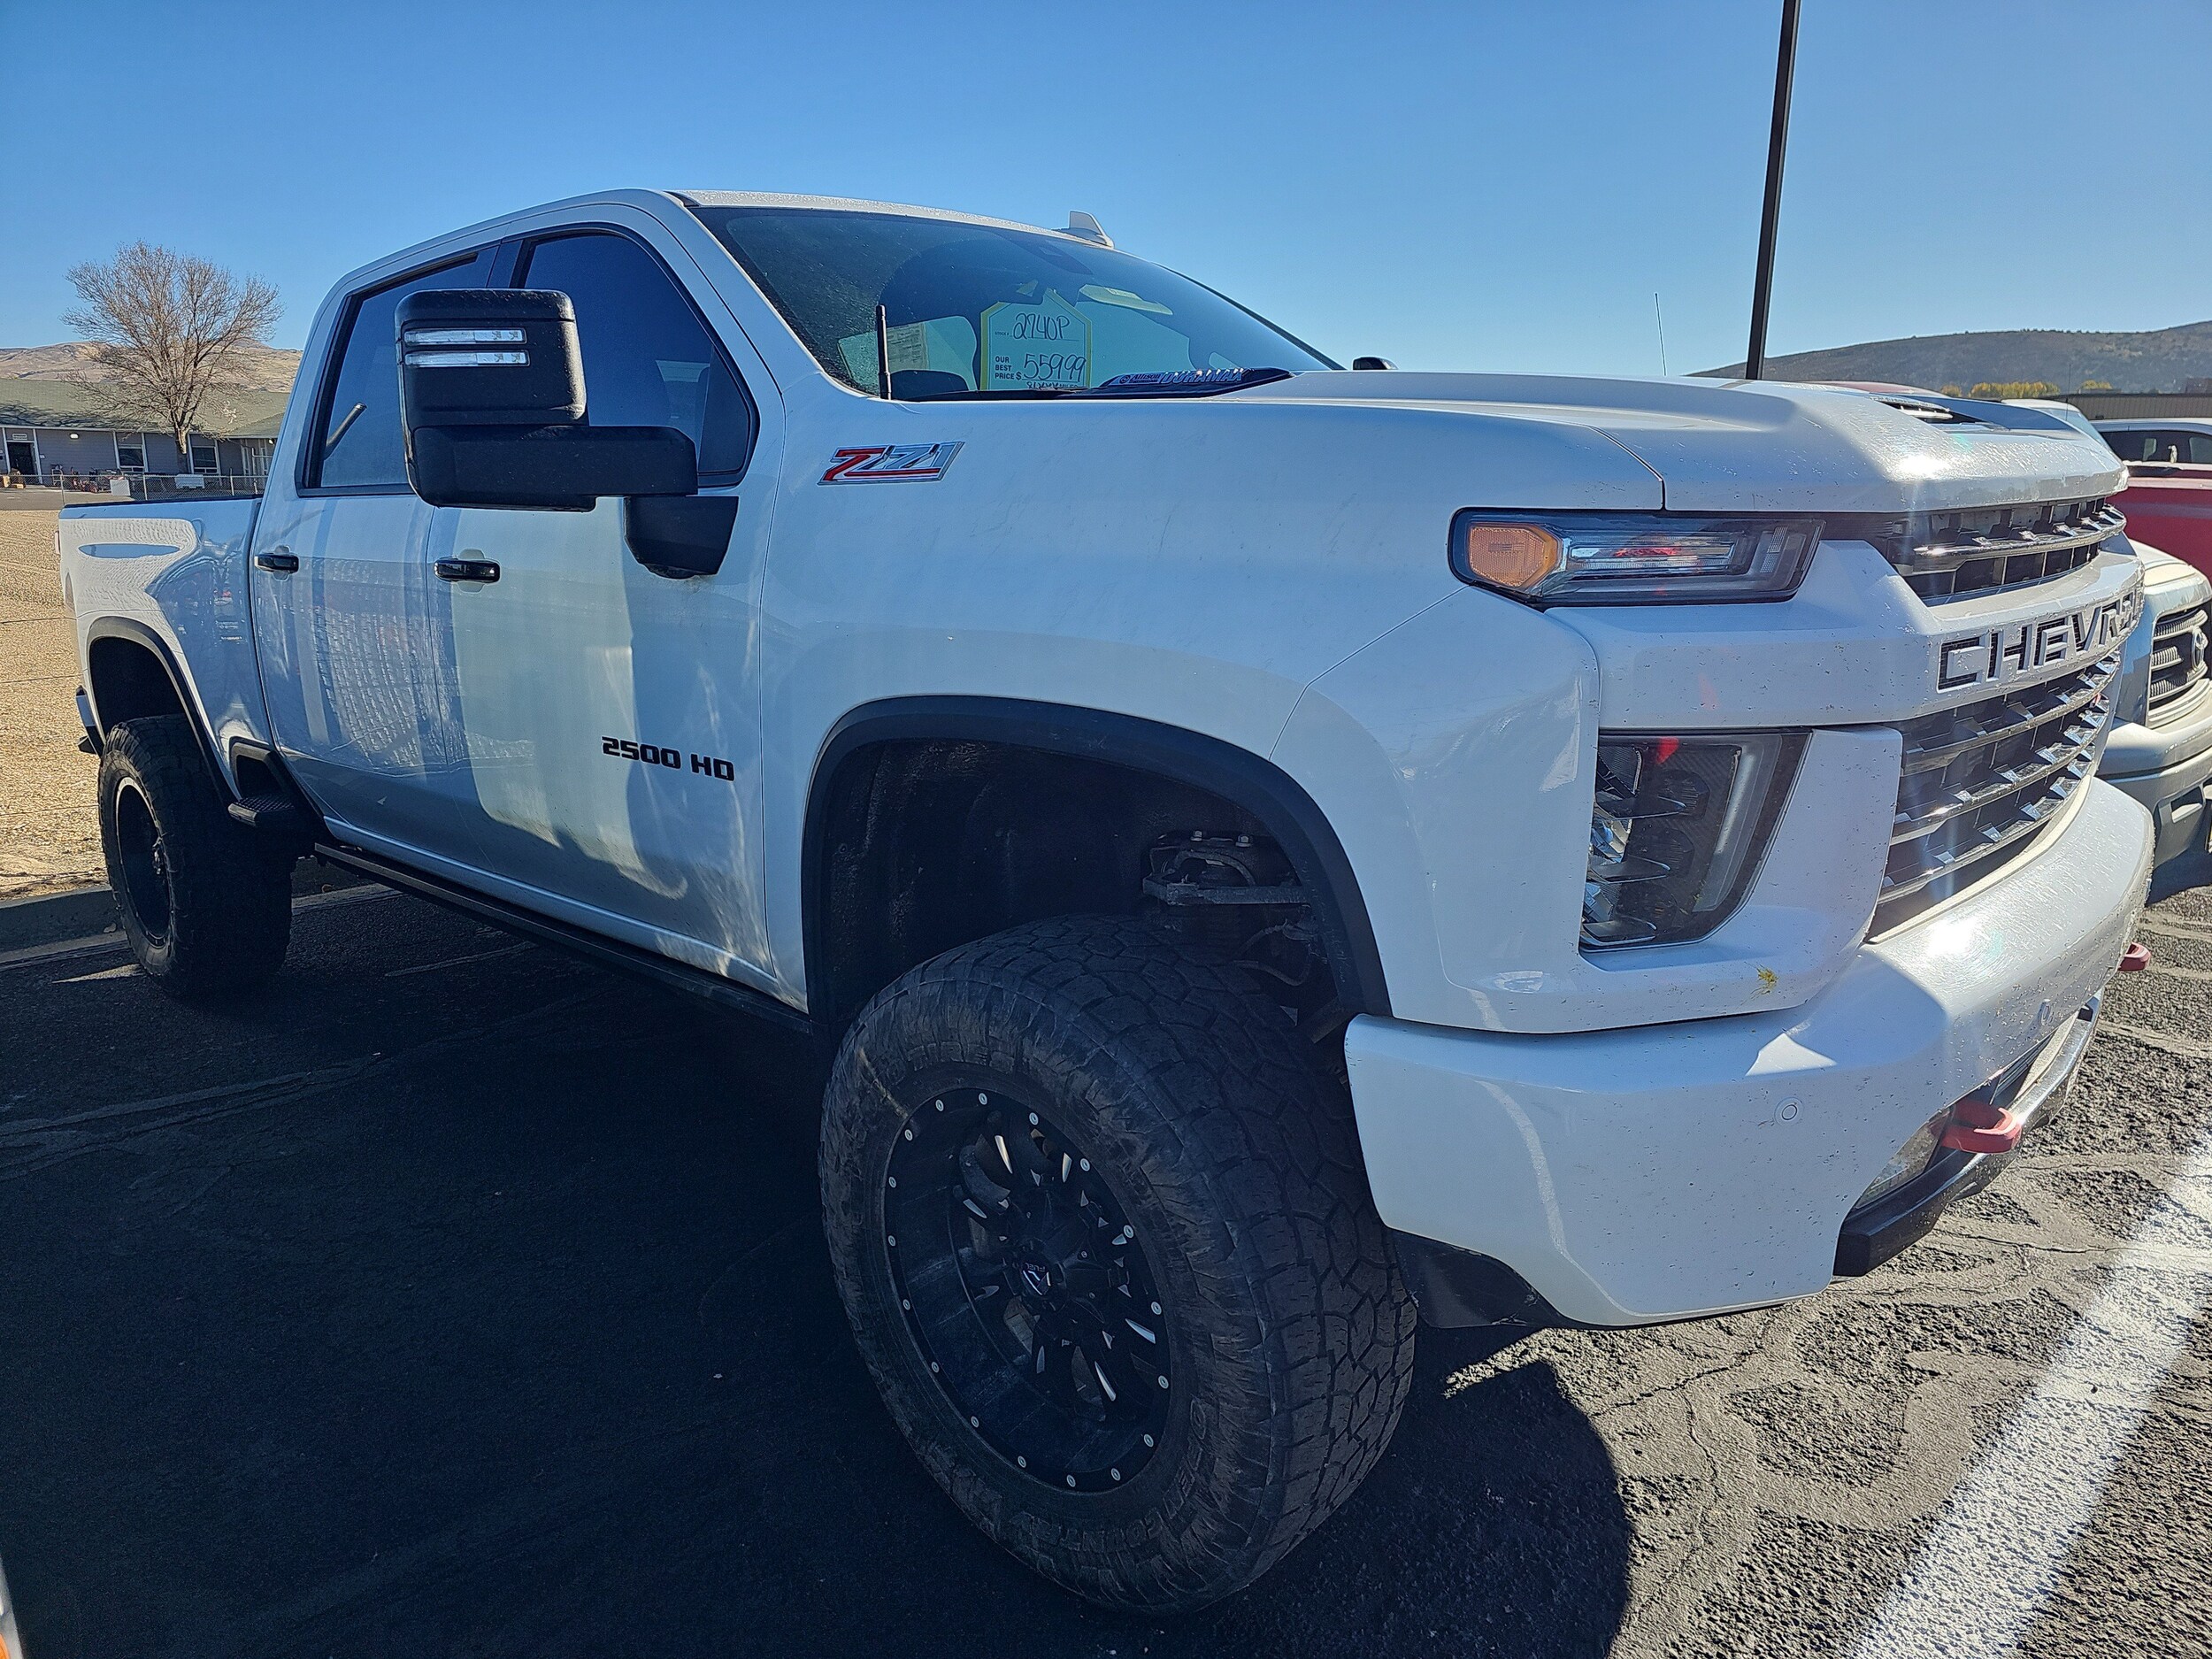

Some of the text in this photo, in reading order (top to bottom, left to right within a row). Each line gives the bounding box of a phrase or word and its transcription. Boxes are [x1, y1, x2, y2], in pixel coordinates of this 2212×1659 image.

[818, 442, 964, 486] Z71
[1937, 589, 2140, 694] CHEVRO
[601, 736, 734, 781] 2500 HD
